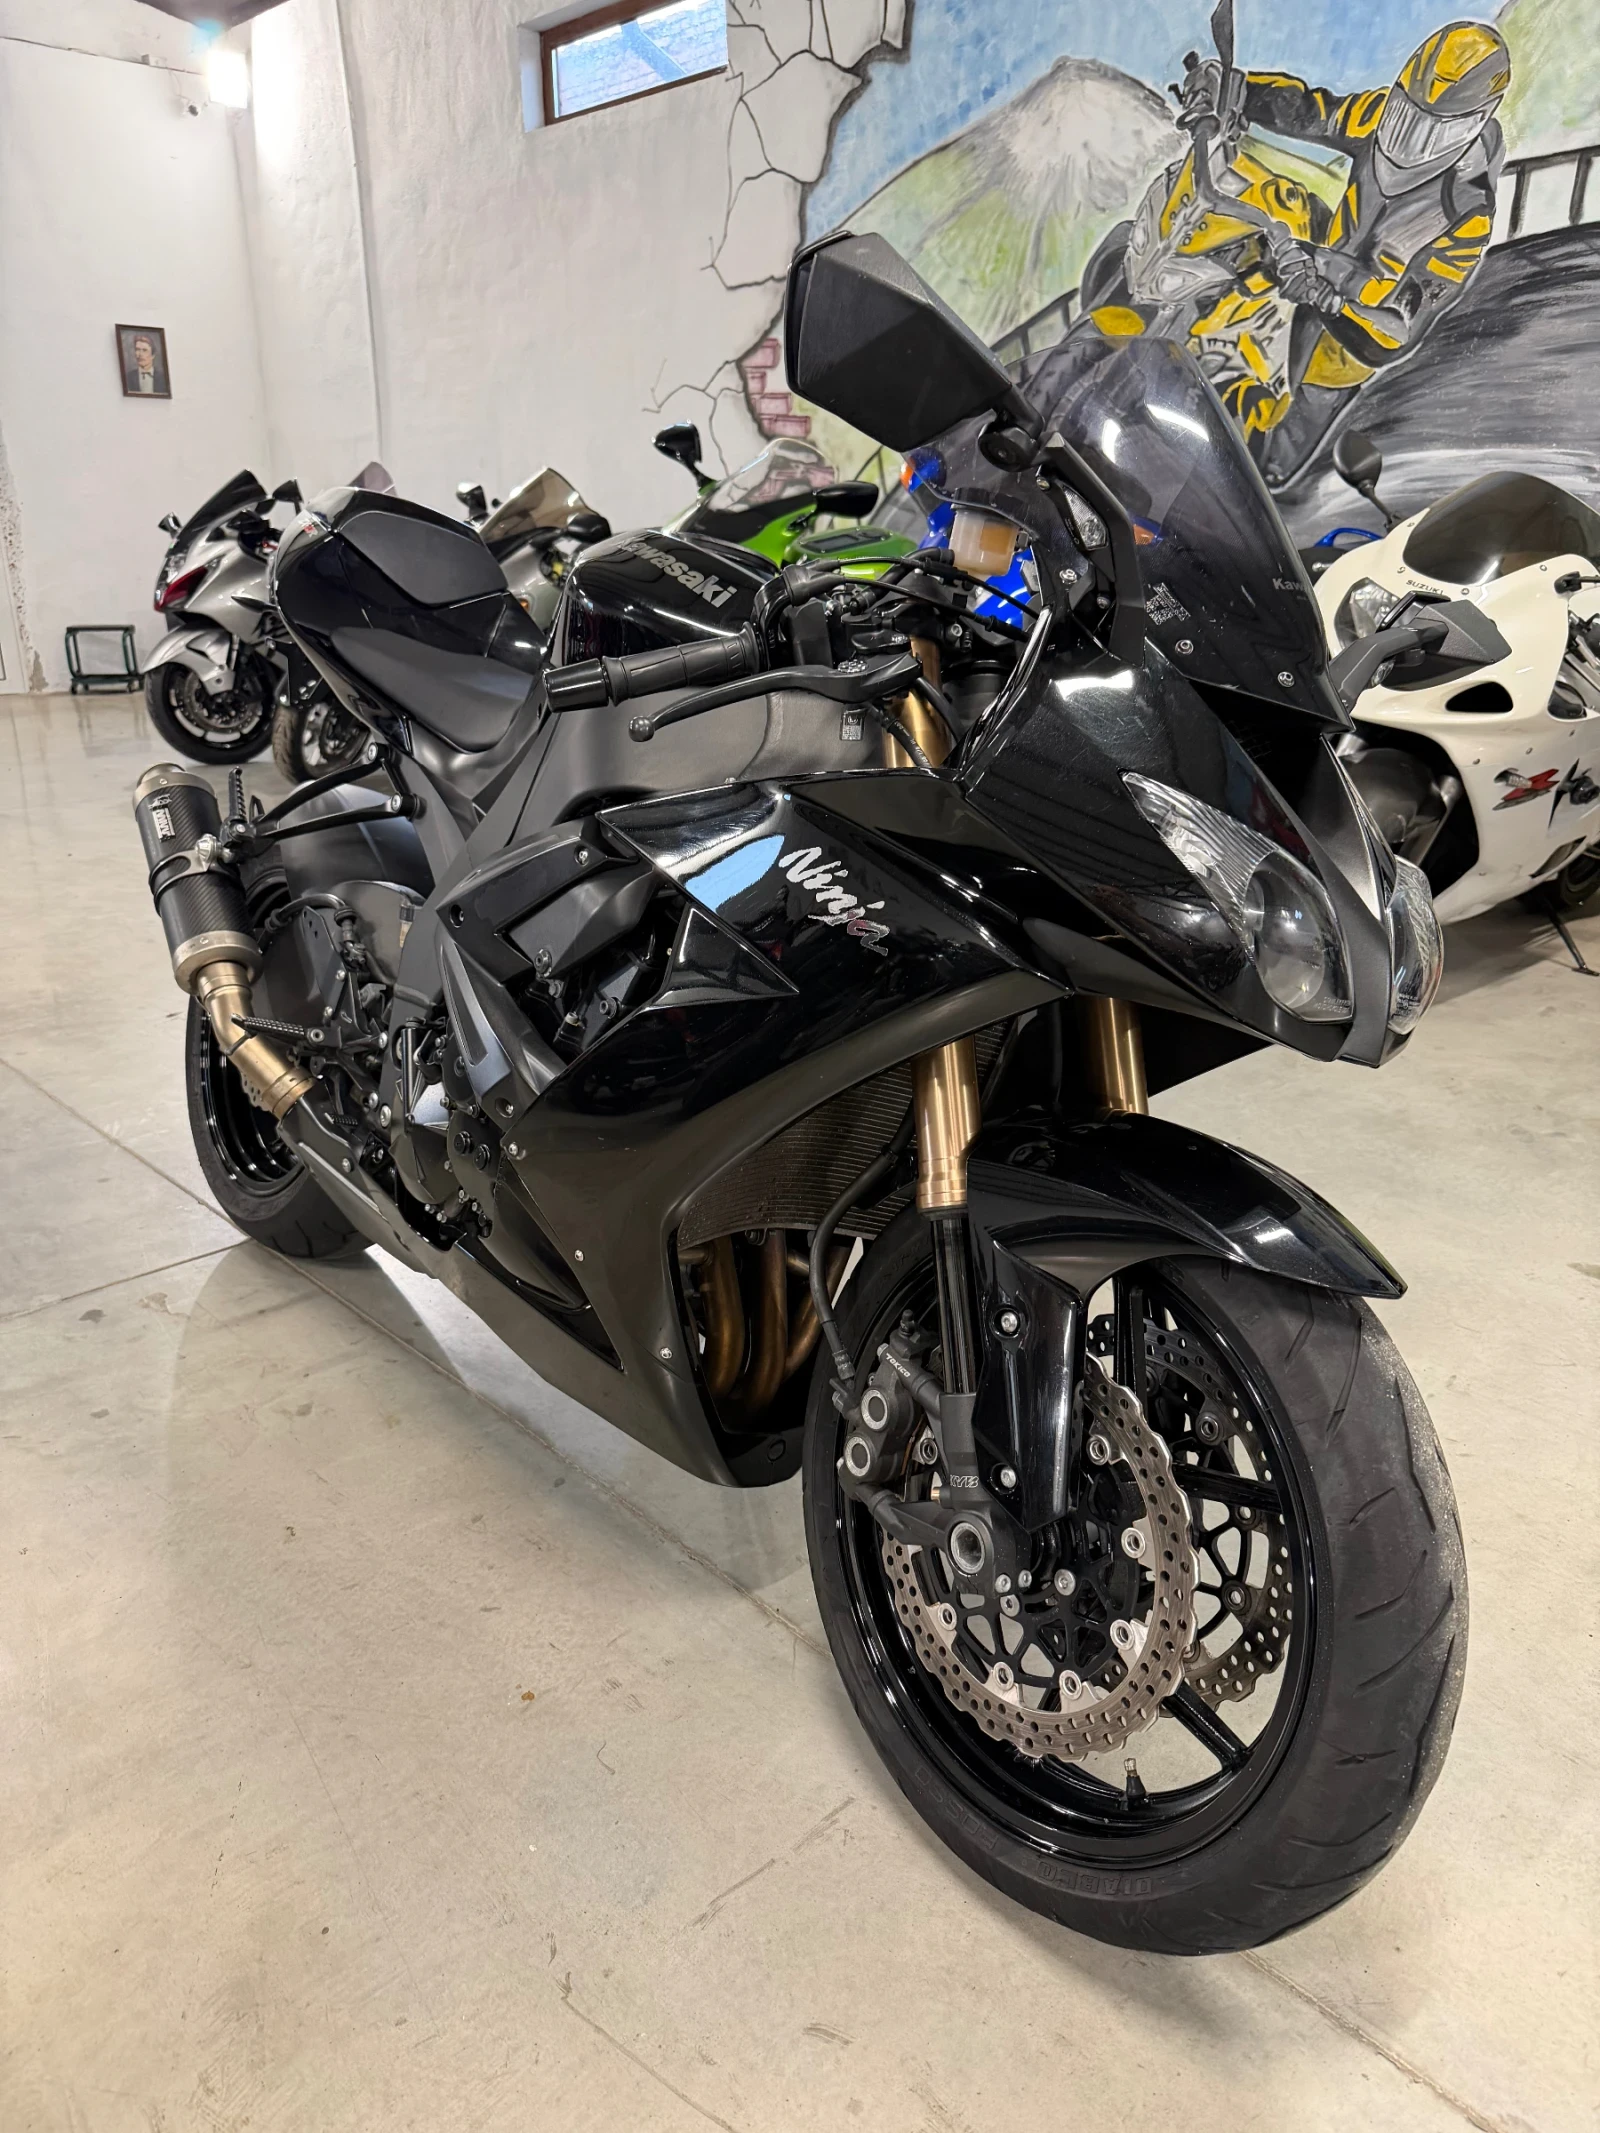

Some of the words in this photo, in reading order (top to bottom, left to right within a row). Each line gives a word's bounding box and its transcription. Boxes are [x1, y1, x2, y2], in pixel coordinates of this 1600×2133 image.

[1406, 579, 1444, 595] SUZUKI
[779, 846, 890, 957] Ninja
[886, 1352, 911, 1378] TOKICO
[1035, 1859, 1154, 1898] DIABLO
